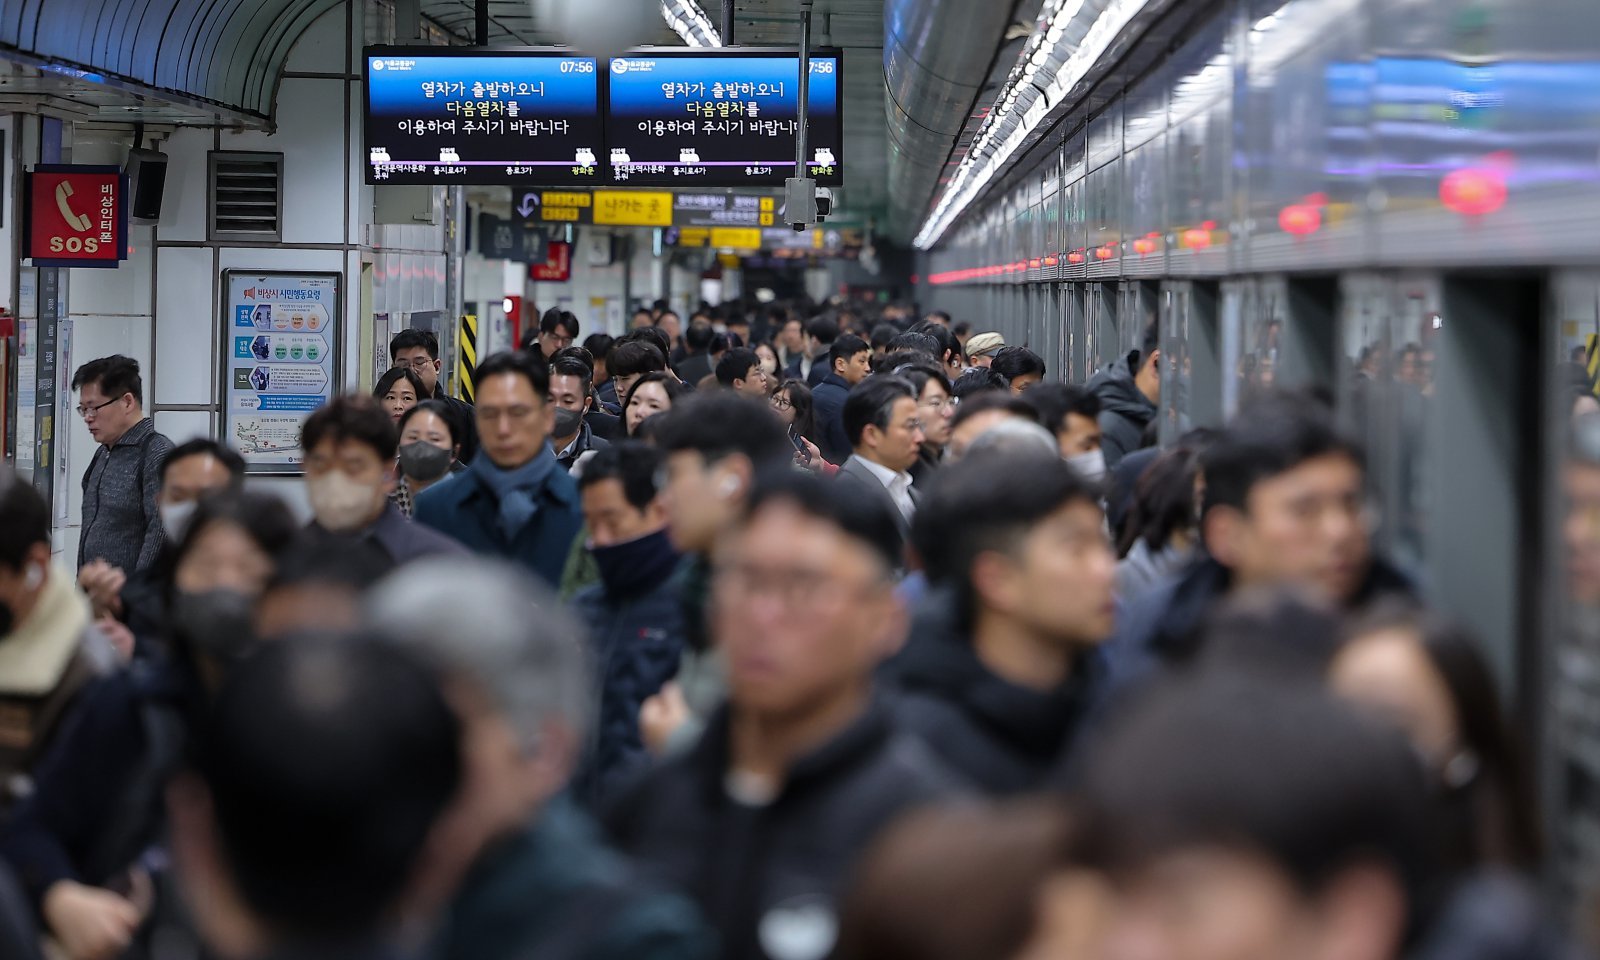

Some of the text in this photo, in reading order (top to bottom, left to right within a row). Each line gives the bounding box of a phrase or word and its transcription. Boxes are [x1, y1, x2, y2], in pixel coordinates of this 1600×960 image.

[560, 61, 593, 73] 07:56
[808, 62, 833, 74] 7:56
[421, 82, 544, 98] 열차가 출발하오니
[661, 82, 784, 98] 열차가 출발하오니
[446, 101, 520, 117] 다음열차를
[686, 102, 760, 117] 다음열차를
[398, 120, 569, 136] 이용하여 주시기 바랍니다
[638, 120, 696, 136] 이용하여
[702, 120, 744, 136] 주시기
[433, 166, 467, 175] 을지로4가
[506, 166, 532, 175] 종로3가
[572, 166, 594, 175] 광화문
[672, 167, 706, 175] 을지로4가
[745, 166, 772, 176] 종로3가
[811, 166, 833, 175] 광화문
[100, 184, 114, 243] 비상인터폰
[50, 237, 98, 253] SOS
[257, 289, 320, 300] 비상시 시민행동요령
